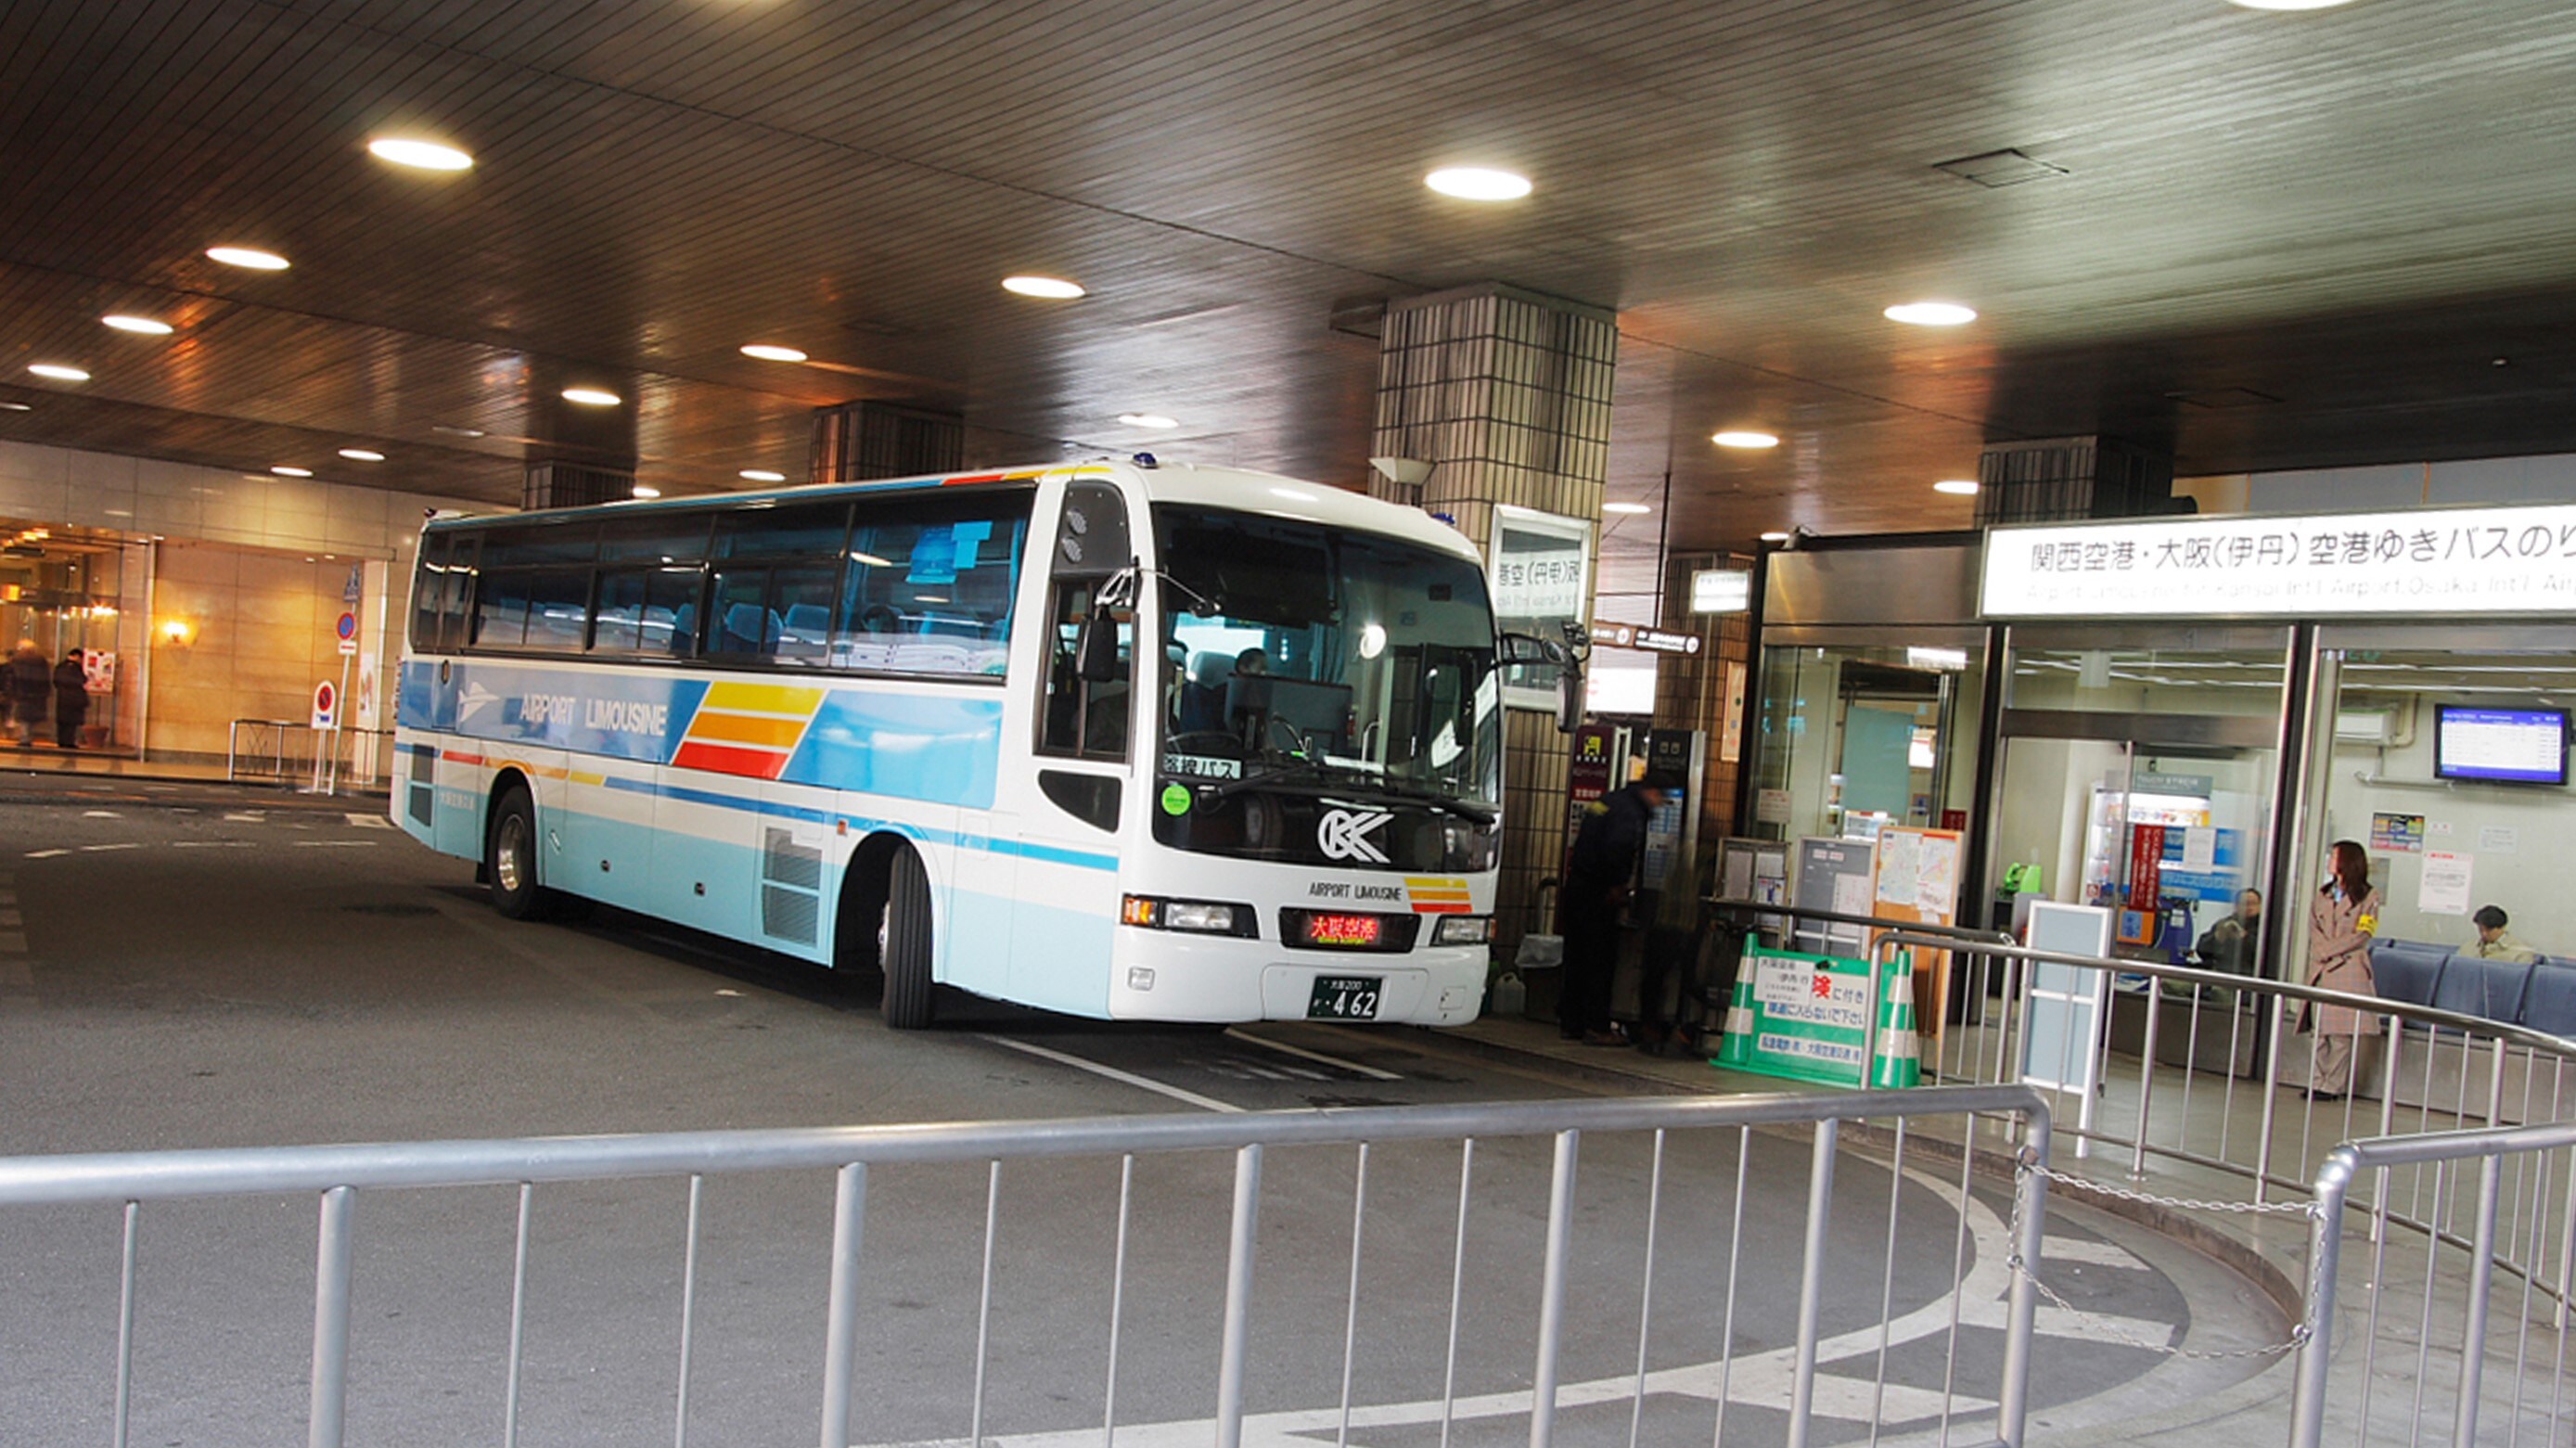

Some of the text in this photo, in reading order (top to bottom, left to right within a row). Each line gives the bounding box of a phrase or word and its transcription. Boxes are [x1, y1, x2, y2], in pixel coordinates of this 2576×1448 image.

[520, 693, 668, 737] AIRPORT LIMOUSINE
[1309, 882, 1403, 902] AIRPORT LIMOUSINE
[1311, 915, 1378, 941] 大阪空港
